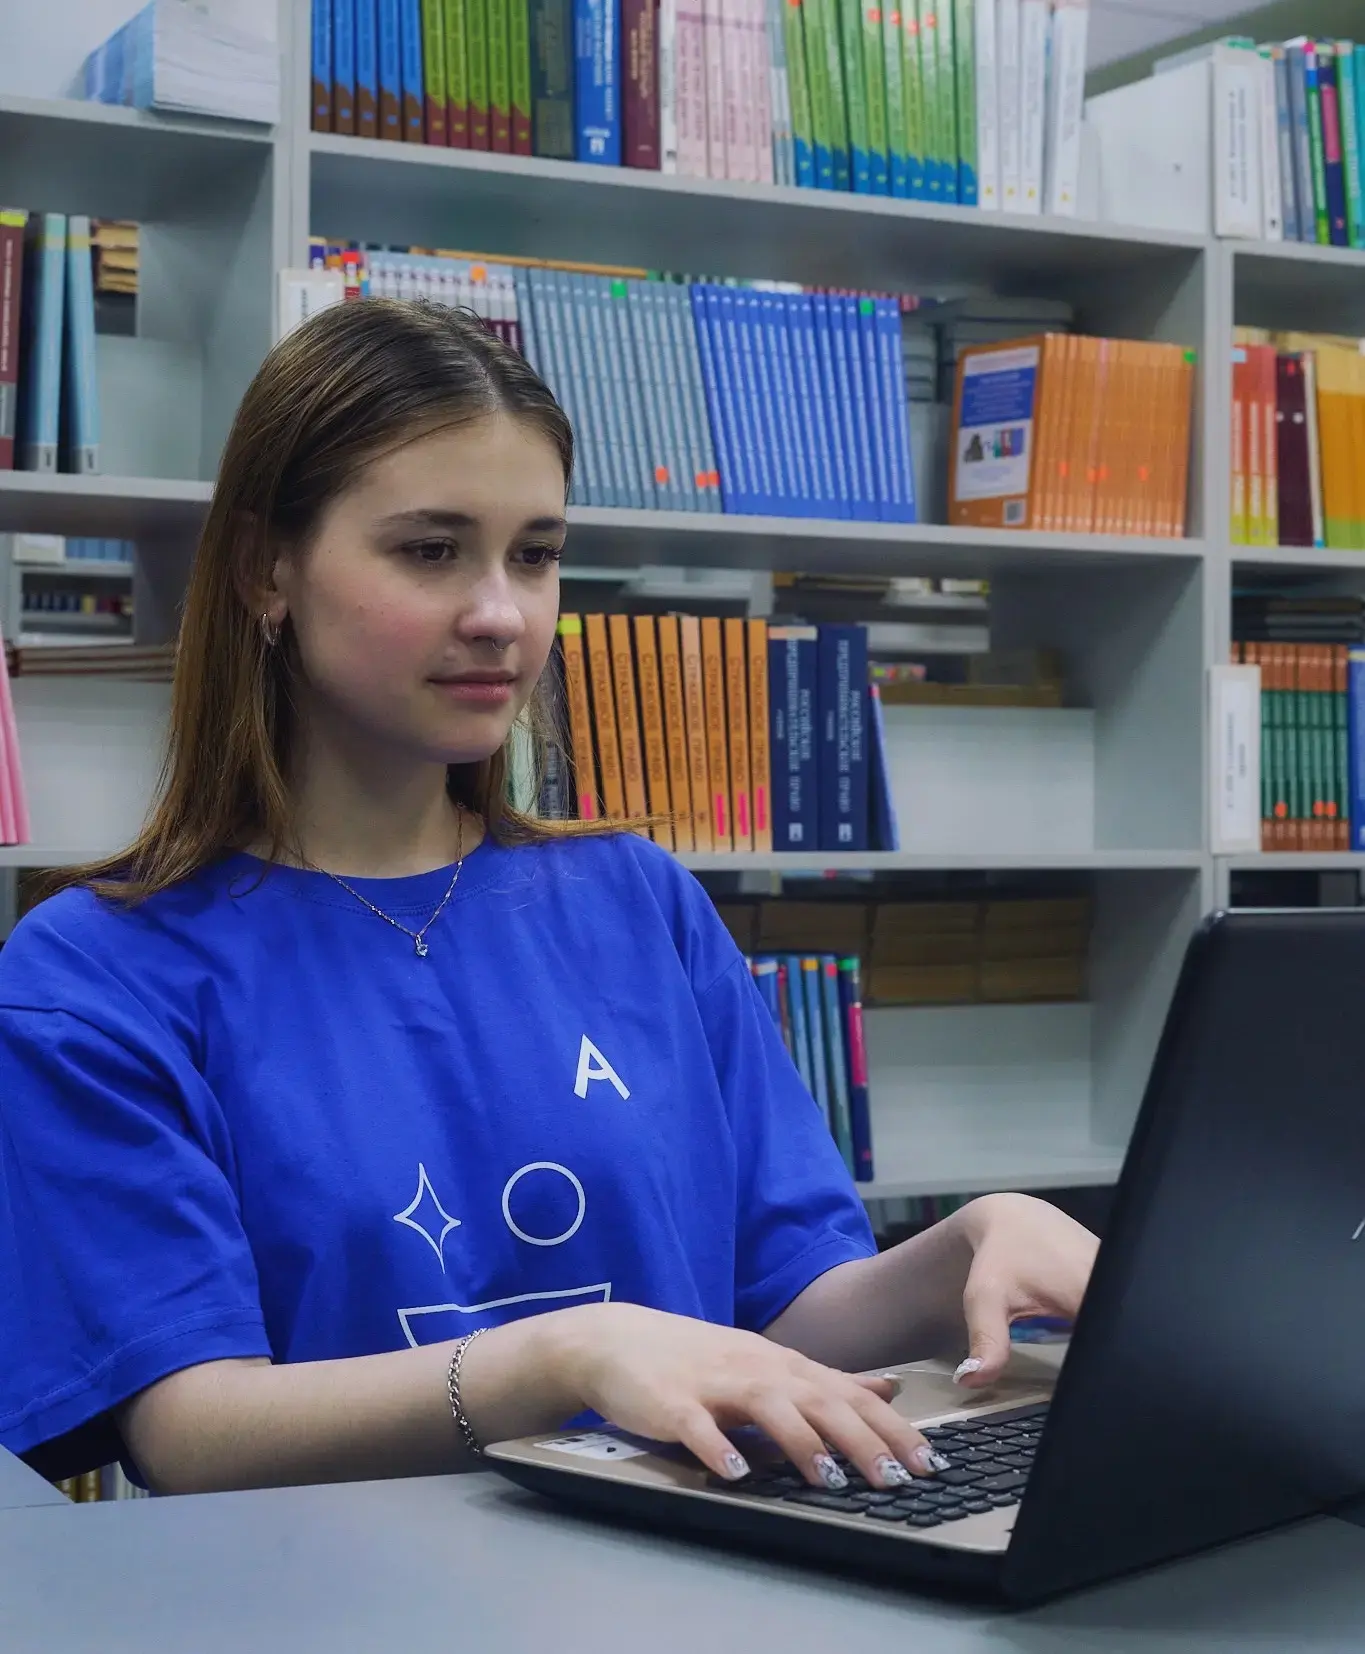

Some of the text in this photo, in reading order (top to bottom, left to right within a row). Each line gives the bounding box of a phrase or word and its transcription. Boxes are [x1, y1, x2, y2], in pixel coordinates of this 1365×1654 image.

[603, 735, 618, 779] ПРАВО
[625, 737, 639, 782] ПРАВО
[649, 737, 664, 782] ПРАВО
[672, 736, 685, 781] ПРАВО
[692, 737, 704, 782] ПРАВО
[710, 739, 724, 782] ПРАВО
[732, 739, 745, 782] ПРАВО
[754, 738, 767, 782] ПРАВО
[789, 775, 801, 812] ПРАВО
[839, 776, 850, 813] ПРАВО
